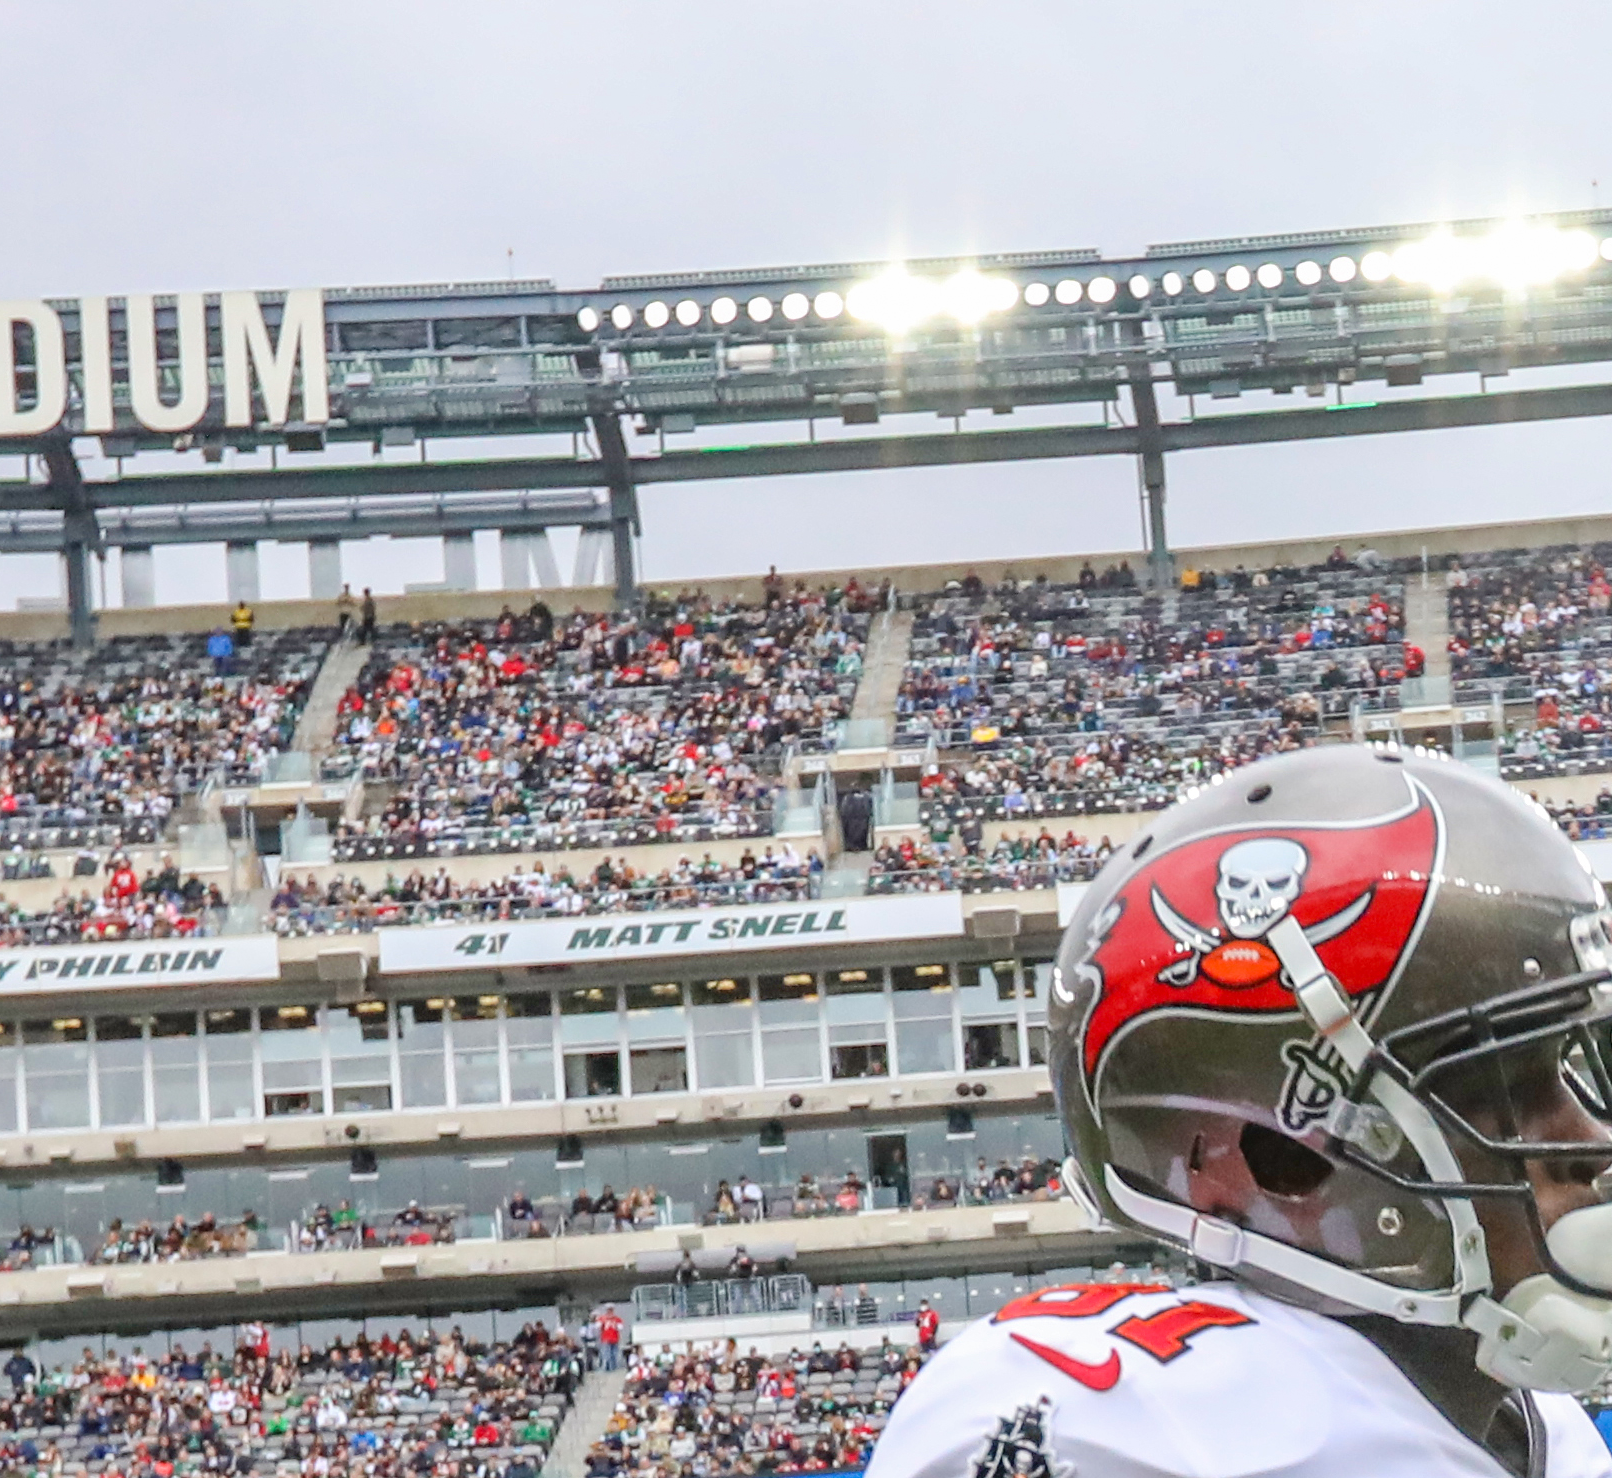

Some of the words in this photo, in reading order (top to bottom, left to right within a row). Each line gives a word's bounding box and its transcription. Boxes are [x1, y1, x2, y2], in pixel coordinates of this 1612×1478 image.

[454, 932, 508, 955] 41
[566, 919, 703, 951] MATT
[707, 909, 847, 940] SNELL
[27, 948, 225, 981] PHILBIN
